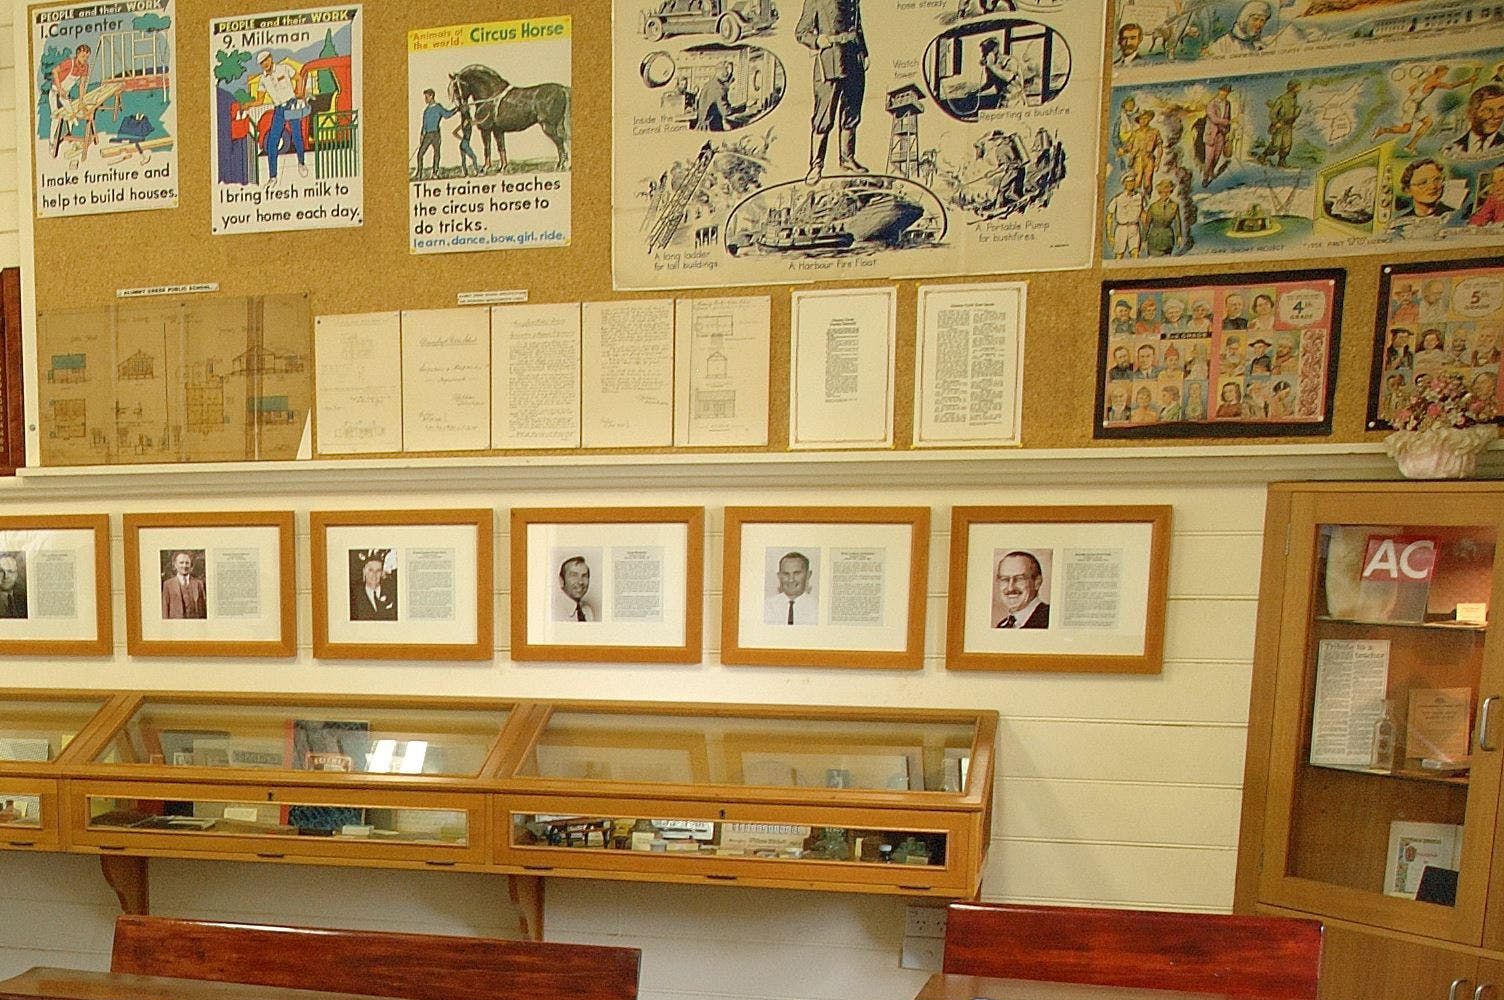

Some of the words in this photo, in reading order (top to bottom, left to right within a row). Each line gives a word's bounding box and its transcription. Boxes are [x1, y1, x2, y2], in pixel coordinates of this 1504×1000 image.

[41, 9, 74, 21] PEOPLE
[79, 6, 96, 18] and
[100, 4, 122, 14] their
[127, 0, 161, 12] WORK
[219, 21, 254, 32] PEOPLE
[260, 17, 279, 27] and
[282, 14, 306, 26] their
[311, 11, 348, 23] WORK
[223, 35, 235, 49] 9.
[242, 31, 310, 46] Milkman
[414, 30, 451, 40] Animals
[455, 28, 463, 36] of
[470, 28, 516, 42] Circus
[521, 23, 564, 38] Horse
[414, 42, 427, 50] the
[634, 116, 656, 125] Inside
[980, 110, 1022, 120] Reporting
[1034, 107, 1070, 116] bushfire
[633, 127, 661, 136] Control
[664, 125, 687, 133] Room
[42, 174, 44, 187] I
[47, 172, 79, 187] make
[85, 169, 139, 184] furniture
[144, 163, 170, 178] and
[221, 190, 223, 203] I
[227, 188, 261, 205] bring
[266, 184, 298, 200] fresh
[304, 182, 331, 197] milk
[336, 185, 349, 195] to
[414, 184, 441, 198] The
[447, 181, 496, 196] trainer
[501, 176, 560, 193] teaches
[42, 194, 70, 210] help
[74, 194, 86, 206] to
[91, 188, 124, 204] build
[130, 187, 178, 200] houses.
[414, 203, 436, 216] the
[442, 200, 484, 214] circus
[490, 198, 531, 212] horse
[535, 197, 549, 209] to
[222, 213, 251, 229] your
[257, 209, 291, 222] home
[296, 205, 327, 220] each
[331, 203, 360, 220] day.
[415, 220, 433, 234] do
[439, 218, 487, 233] tricks.
[986, 222, 1021, 231] Portable
[1026, 221, 1050, 231] Pump
[979, 234, 989, 242] for
[993, 233, 1035, 242] bushfires
[663, 252, 680, 262] long
[685, 251, 710, 259] ladder
[788, 262, 795, 270] A
[798, 261, 832, 271] Harbour
[855, 259, 877, 267] Float
[667, 261, 679, 269] tall
[683, 261, 718, 271] buildings
[1363, 539, 1436, 580] AC
